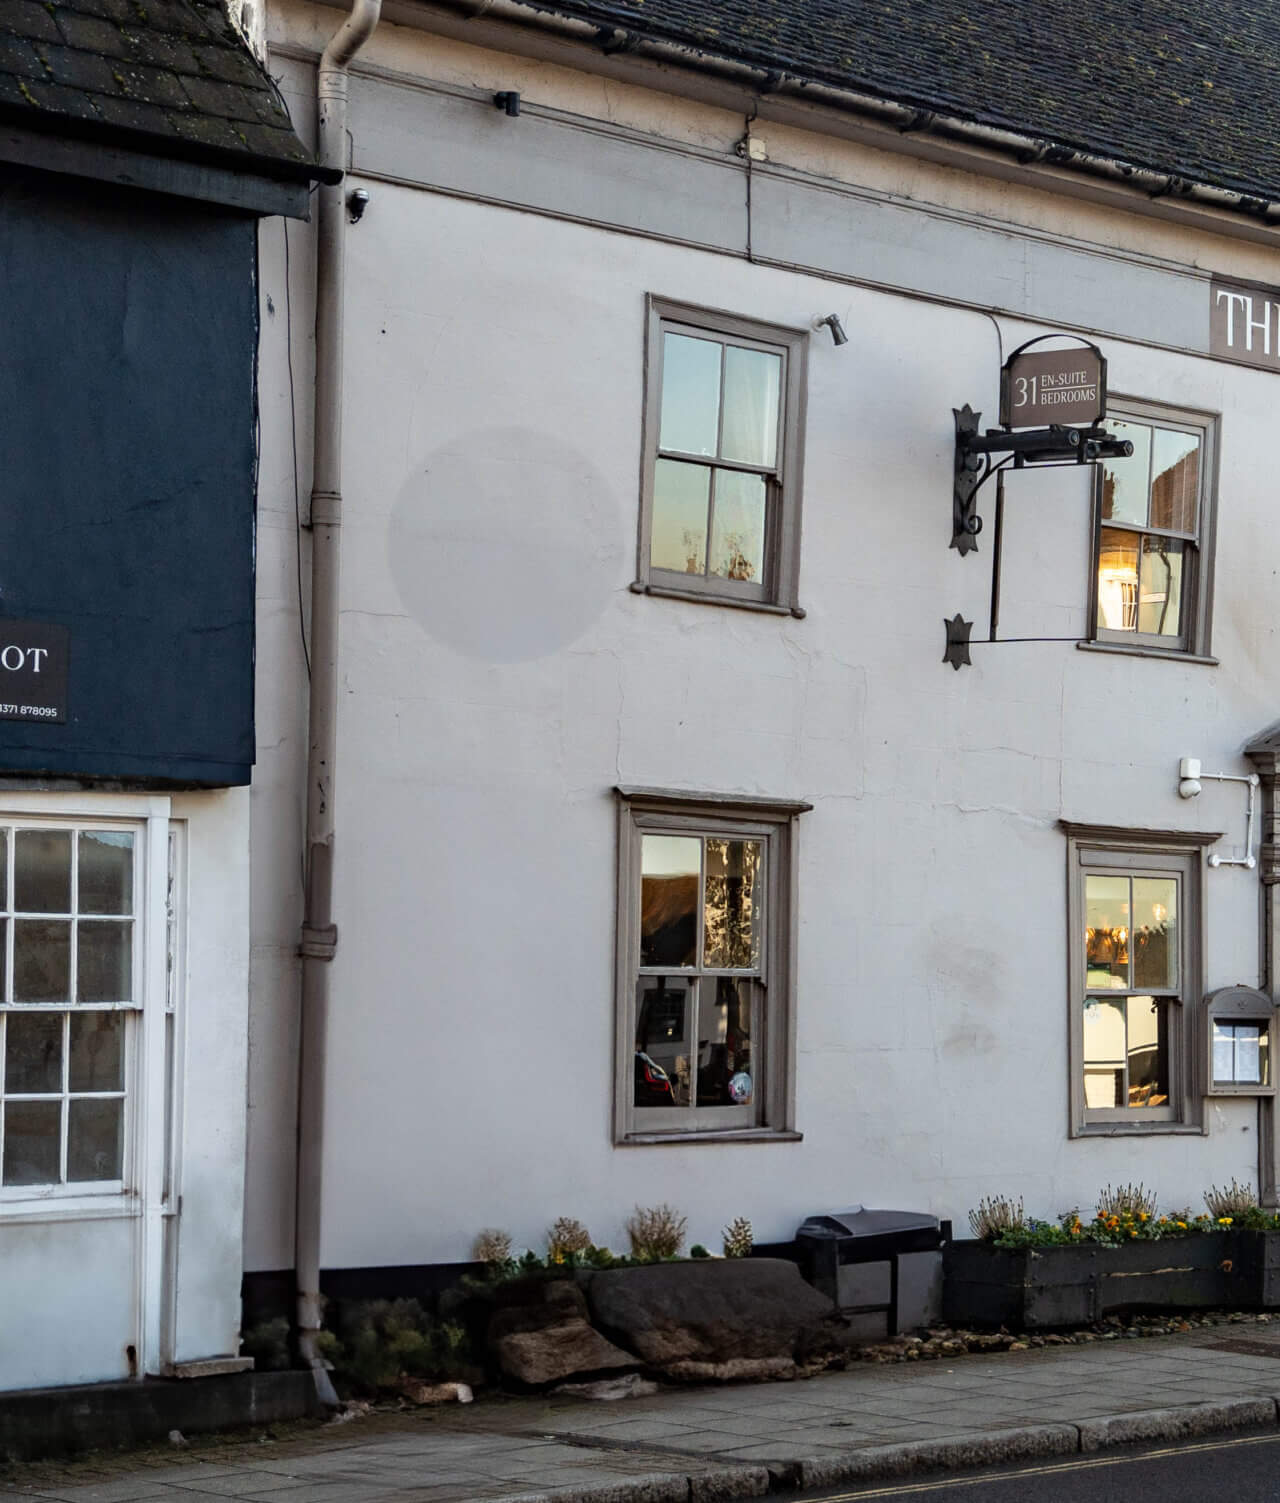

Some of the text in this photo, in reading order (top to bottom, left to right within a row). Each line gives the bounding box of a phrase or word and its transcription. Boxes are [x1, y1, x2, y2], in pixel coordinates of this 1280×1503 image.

[1041, 371, 1087, 387] EN-SUITE
[1014, 375, 1037, 407] 31
[1041, 388, 1096, 405] BEDROOMS
[1, 645, 48, 672] OT
[20, 705, 57, 717] 878095
